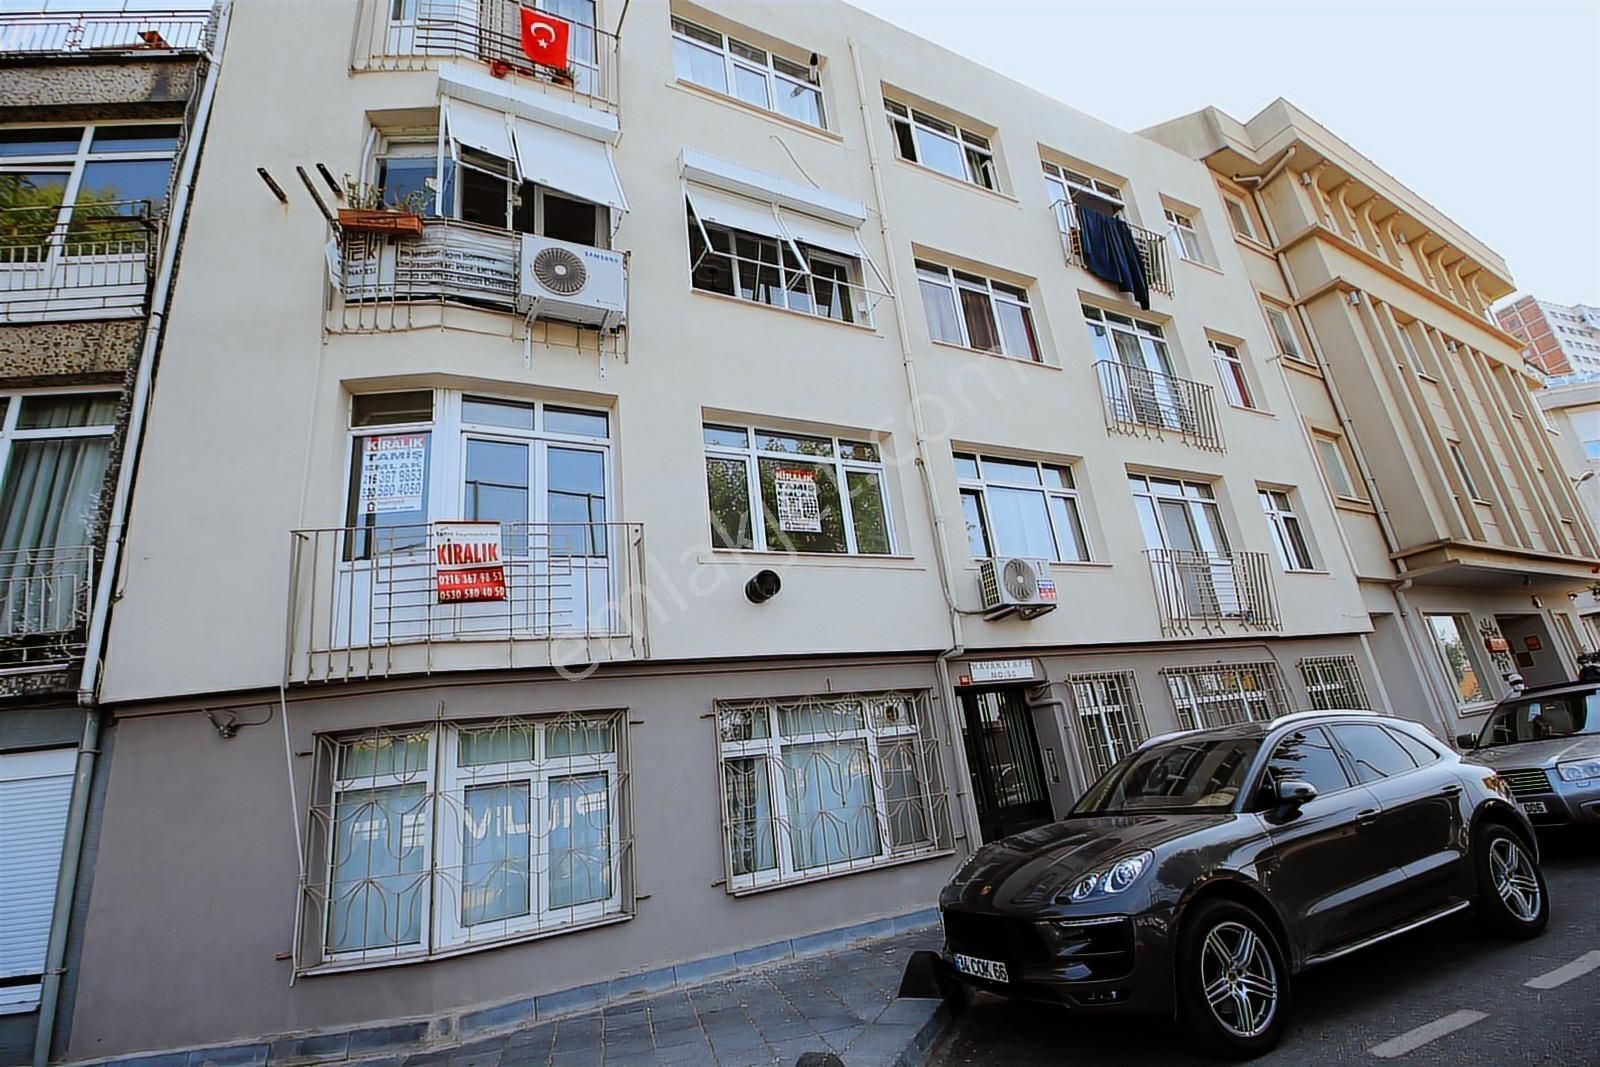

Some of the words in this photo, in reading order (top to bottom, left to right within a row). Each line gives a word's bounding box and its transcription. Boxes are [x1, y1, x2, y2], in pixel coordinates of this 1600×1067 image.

[585, 250, 618, 263] SAMSUNG
[364, 461, 423, 471] EMLAK
[437, 537, 498, 565] KİRALIK
[438, 574, 461, 586] 0216
